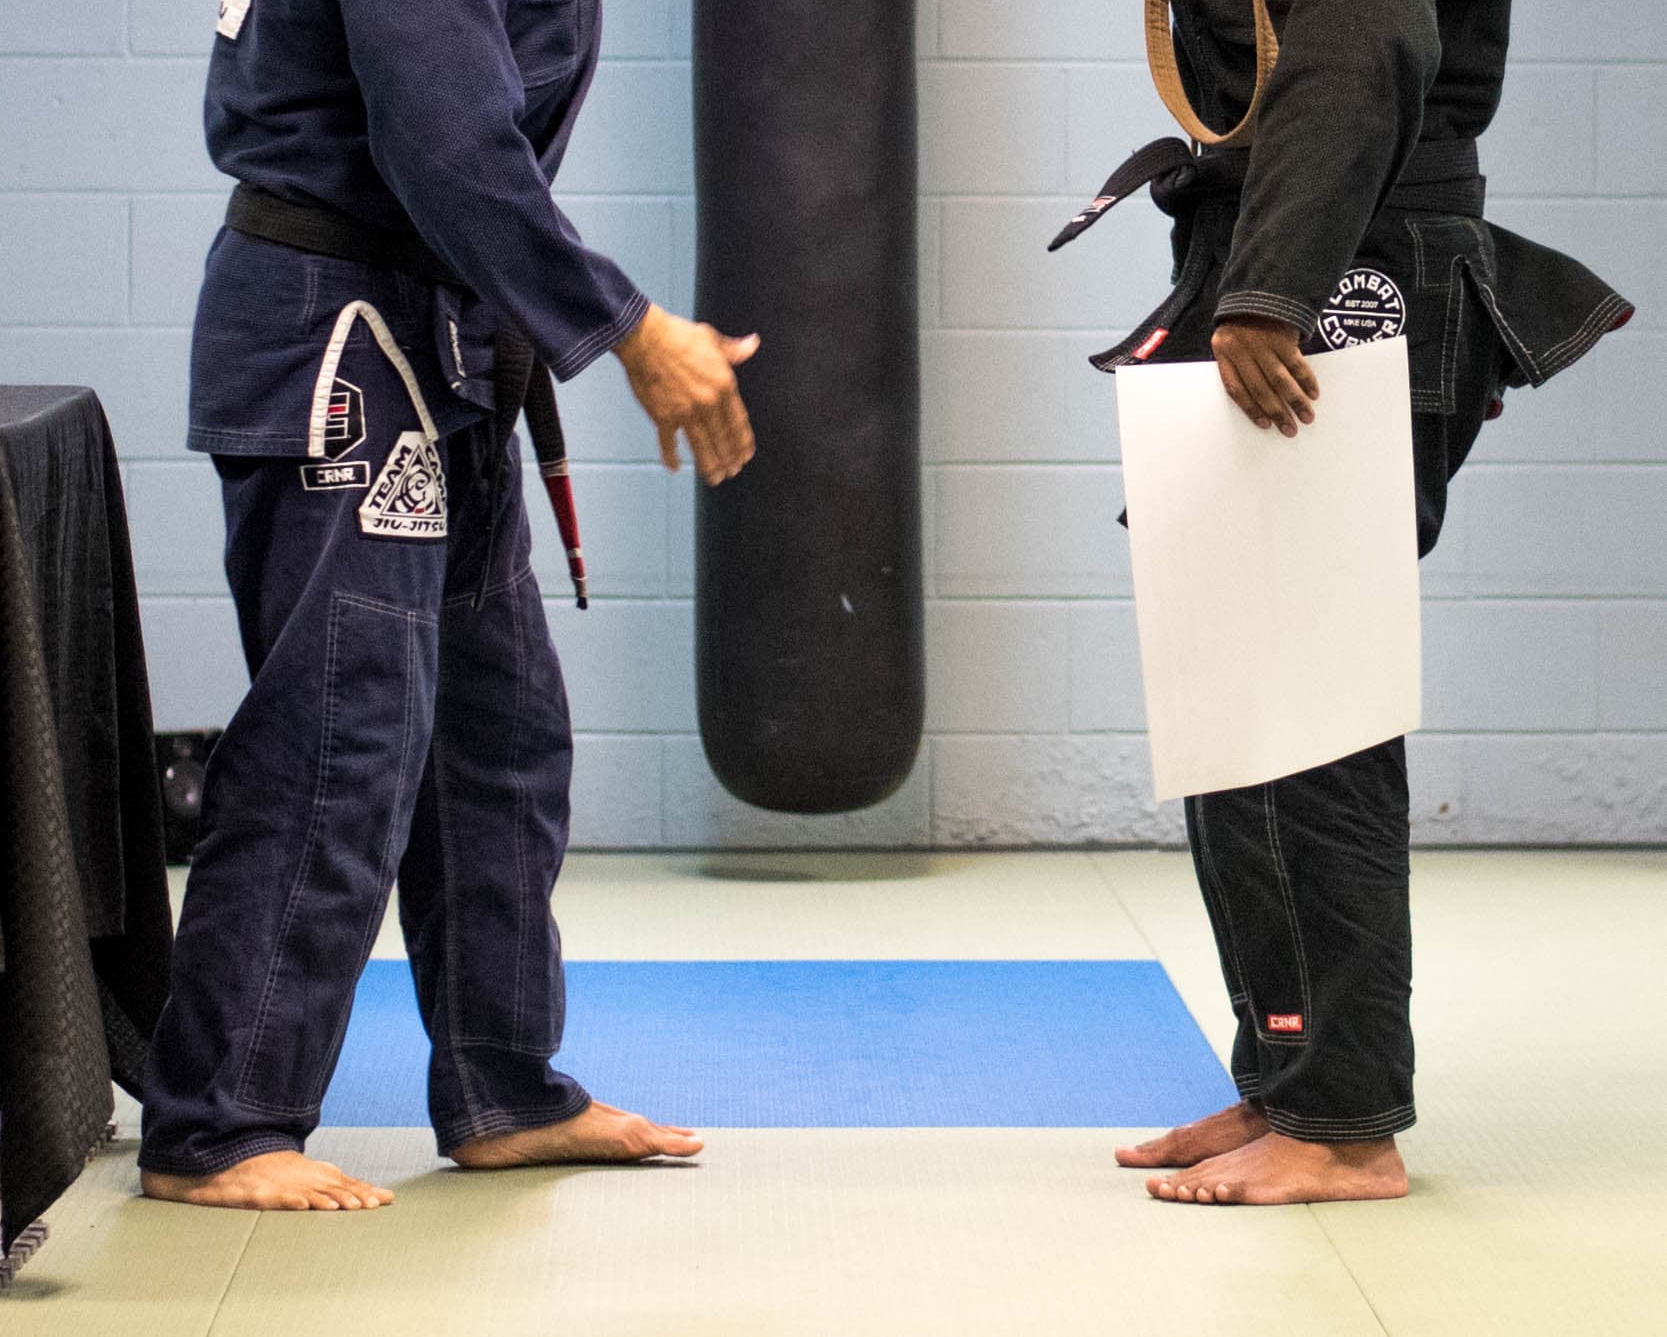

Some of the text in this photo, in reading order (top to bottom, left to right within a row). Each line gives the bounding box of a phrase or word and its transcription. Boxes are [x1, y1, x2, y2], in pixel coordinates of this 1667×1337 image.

[1329, 274, 1400, 310] COMBAT
[1361, 319, 1377, 327] USA
[317, 467, 356, 483] CRNR
[368, 444, 413, 510] TEAM
[373, 518, 444, 532] JIU-JITSU
